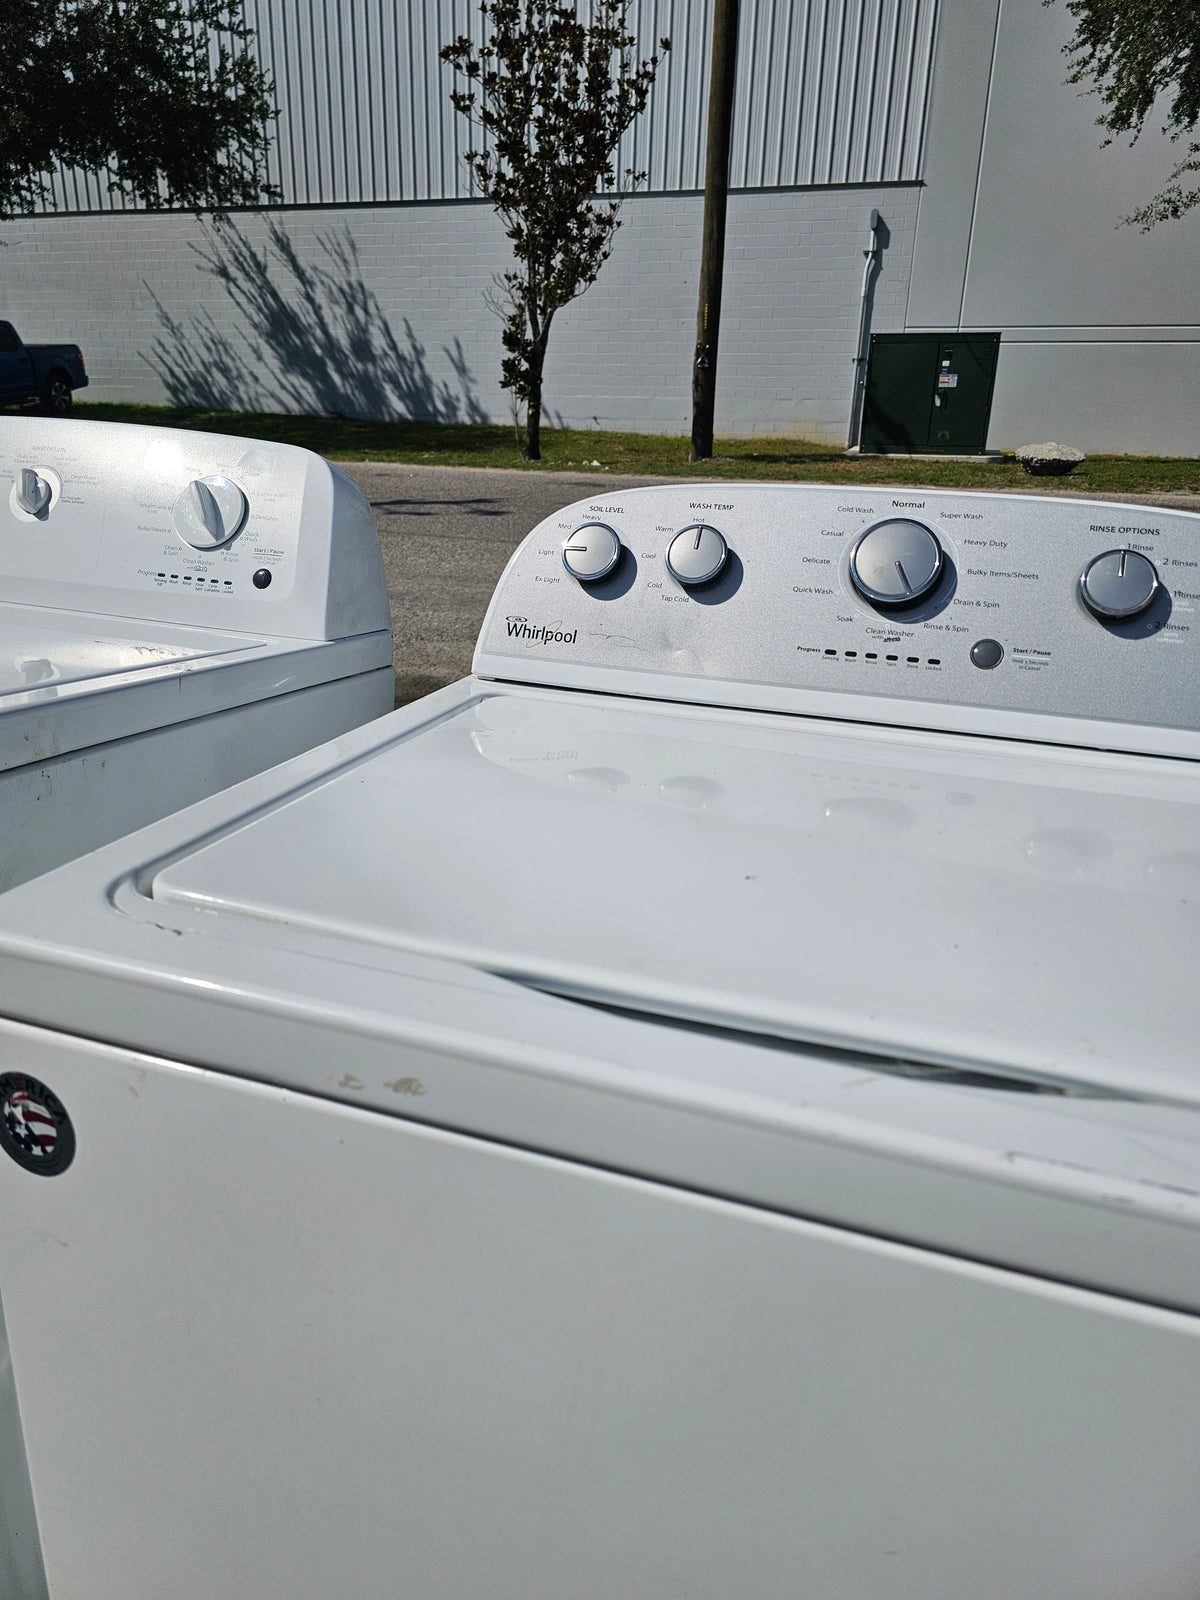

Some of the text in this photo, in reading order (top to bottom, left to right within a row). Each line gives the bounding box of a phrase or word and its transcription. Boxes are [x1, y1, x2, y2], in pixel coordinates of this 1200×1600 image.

[589, 505, 604, 513] SOIL
[891, 500, 926, 509] Normal
[940, 512, 962, 520] Super
[821, 529, 844, 537] Casual
[1089, 525, 1161, 536] RINSE OPTIONS
[963, 538, 1008, 548] Heavy Duty
[802, 556, 831, 565] Delicate
[1163, 558, 1198, 568] 2 Rinses
[137, 569, 157, 577] Progress
[967, 569, 1039, 580] Bulky Items/Sheets
[543, 576, 560, 584] Light
[792, 586, 813, 594] Quick
[1177, 591, 1200, 600] Rinse
[953, 598, 974, 607] Drain
[983, 601, 1000, 609] Spin
[923, 622, 944, 631] Rinse
[952, 624, 969, 633] Spin
[1154, 620, 1190, 631] 2 Rinses
[506, 622, 577, 645] Whirlpool
[865, 627, 914, 638] Clean Washer
[796, 645, 821, 653] Progress
